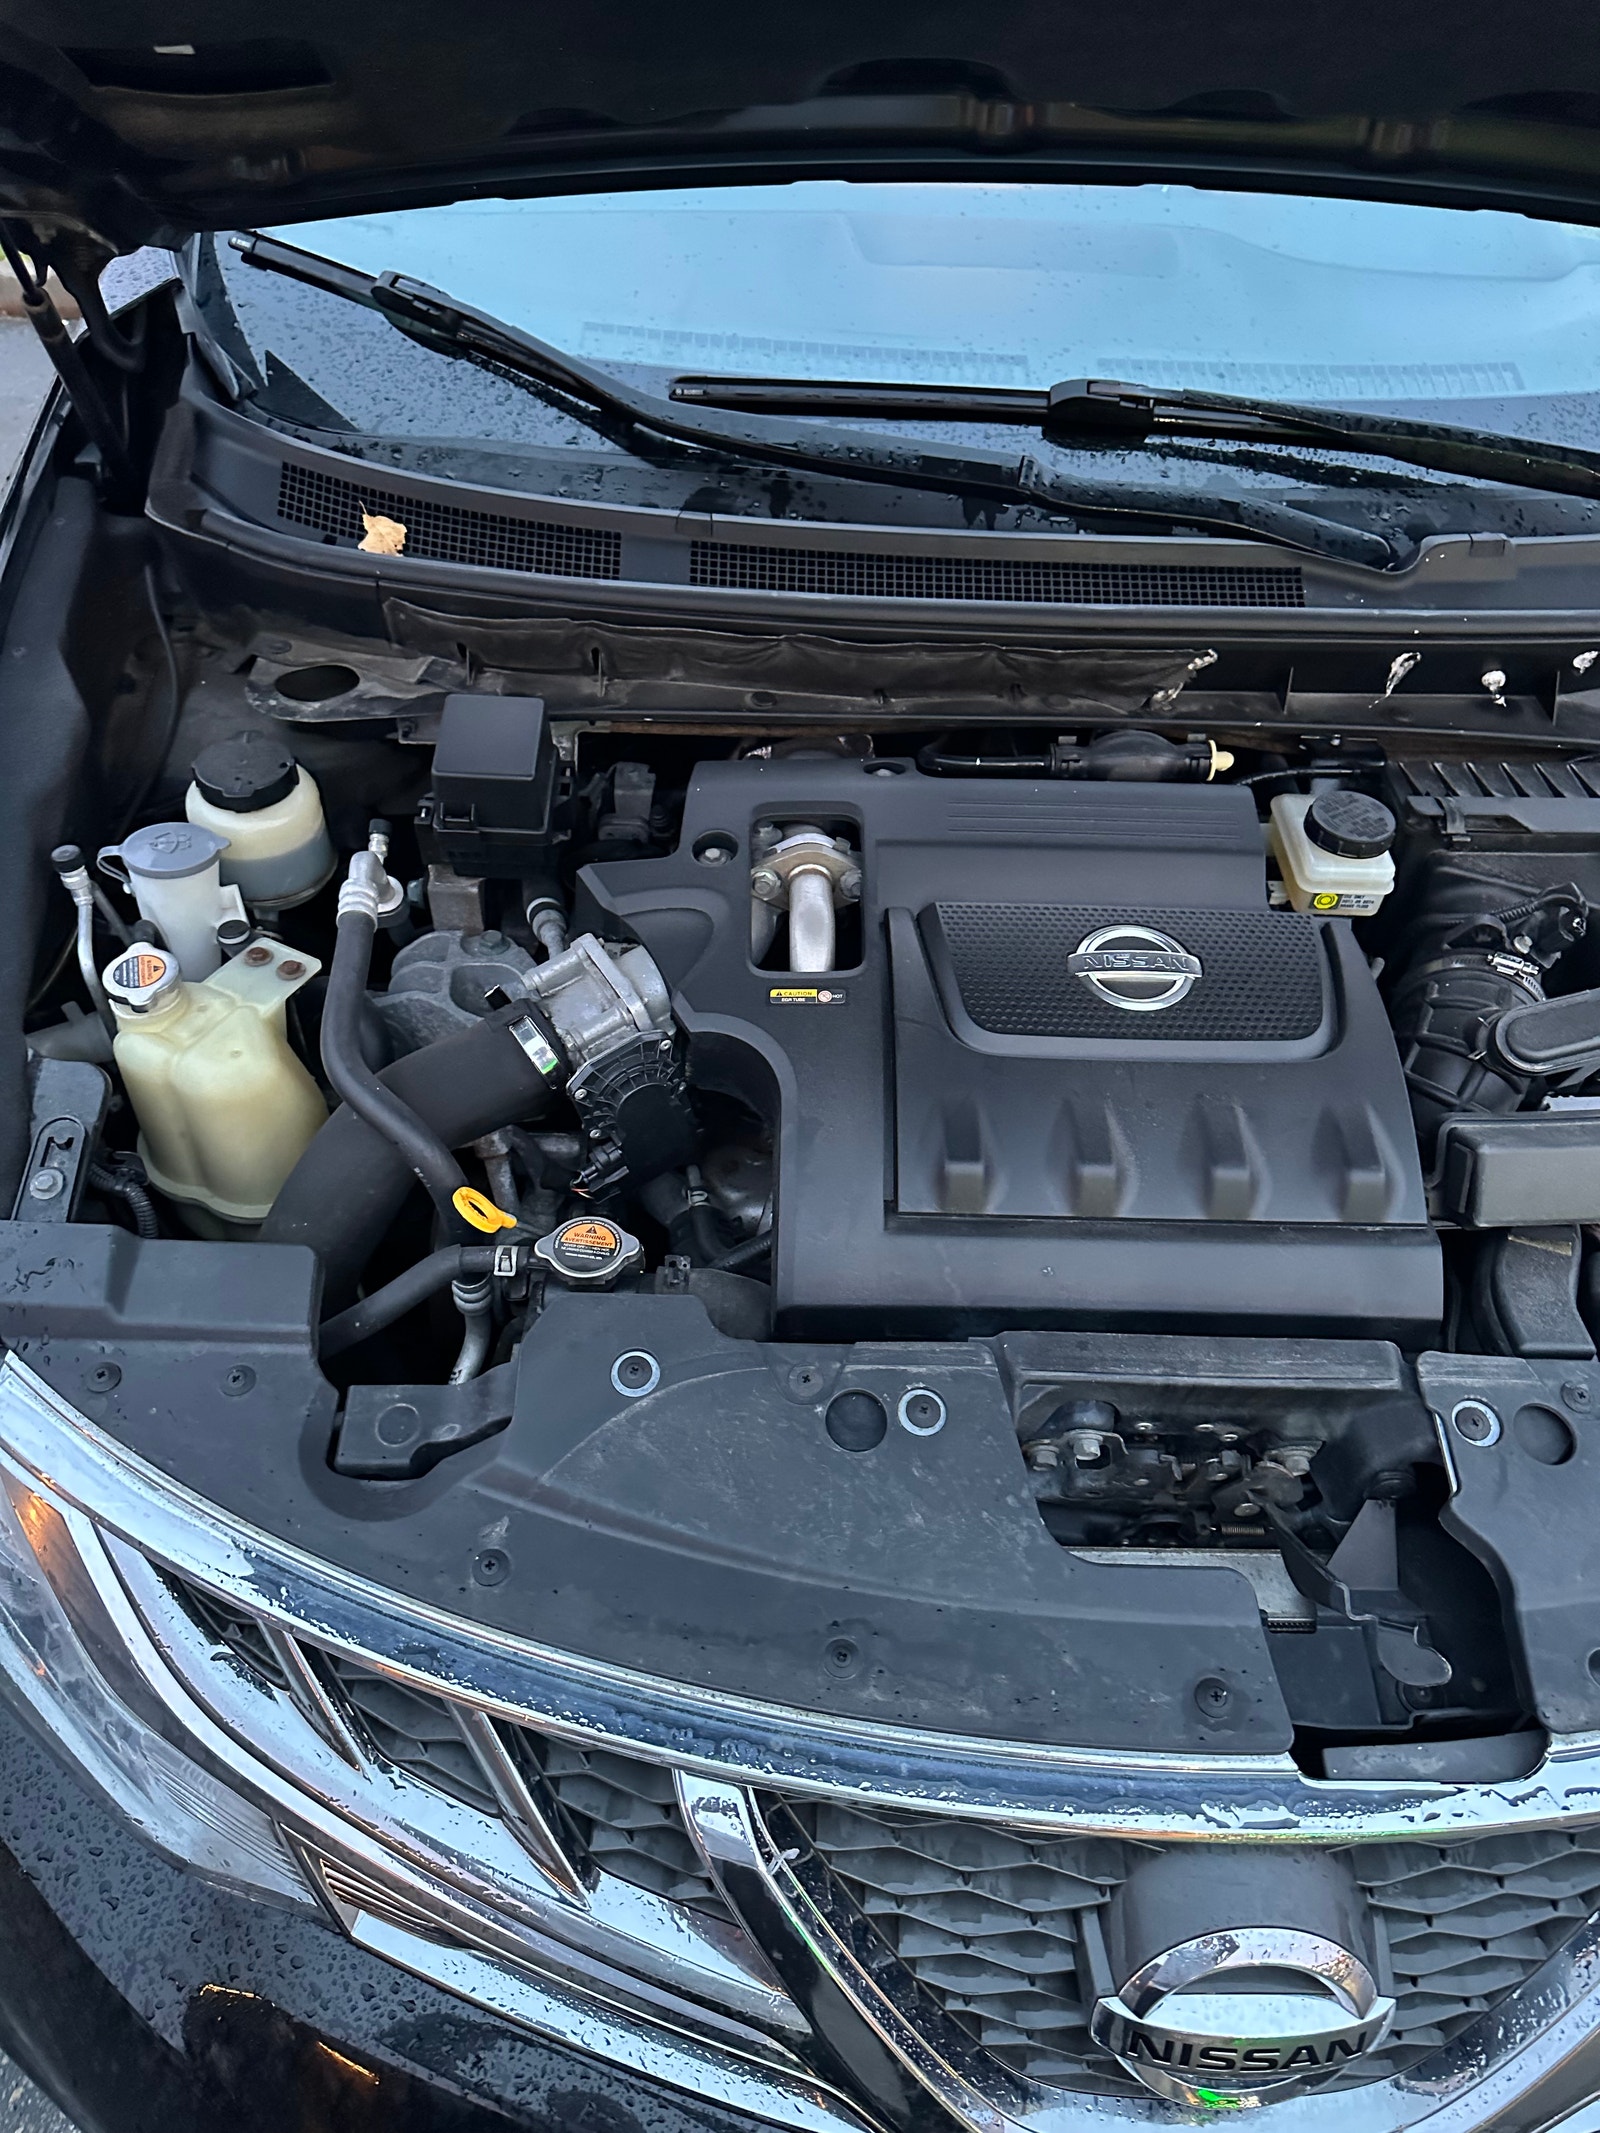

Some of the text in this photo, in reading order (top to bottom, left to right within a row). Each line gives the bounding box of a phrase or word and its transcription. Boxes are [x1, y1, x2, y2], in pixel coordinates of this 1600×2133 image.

[1082, 954, 1190, 971] NISSAN
[564, 1237, 614, 1247] AVERTISSEMENT
[573, 1232, 607, 1241] WARNING
[1127, 2030, 1368, 2072] NISSAN
